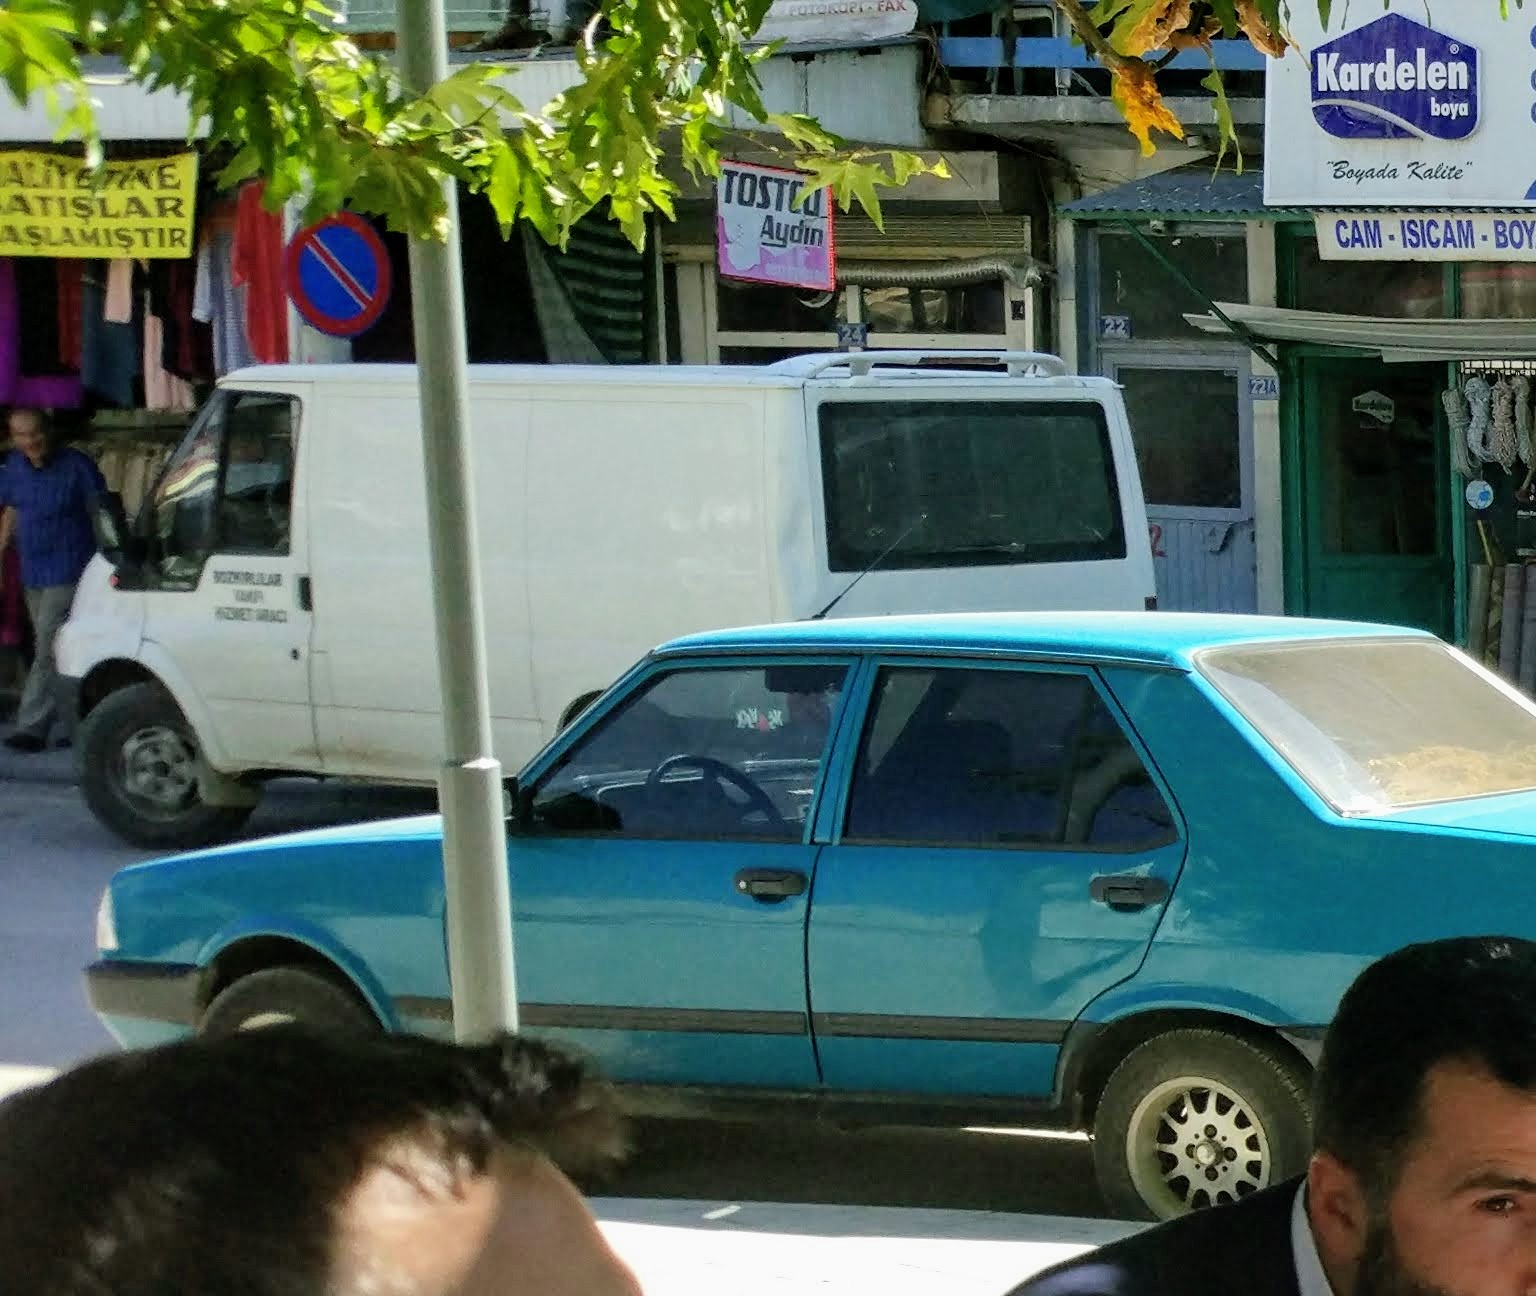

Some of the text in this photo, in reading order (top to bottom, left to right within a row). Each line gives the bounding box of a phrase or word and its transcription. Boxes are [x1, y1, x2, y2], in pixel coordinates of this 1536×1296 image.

[1317, 47, 1469, 93] Kardelen
[1430, 96, 1469, 120] boya
[0, 194, 186, 225] ATIŞLAR
[0, 225, 188, 253] AŞLAMIŞTIR
[1335, 218, 1383, 250] CAM
[1400, 218, 1476, 250] ISICAM
[1103, 317, 1128, 338] 22
